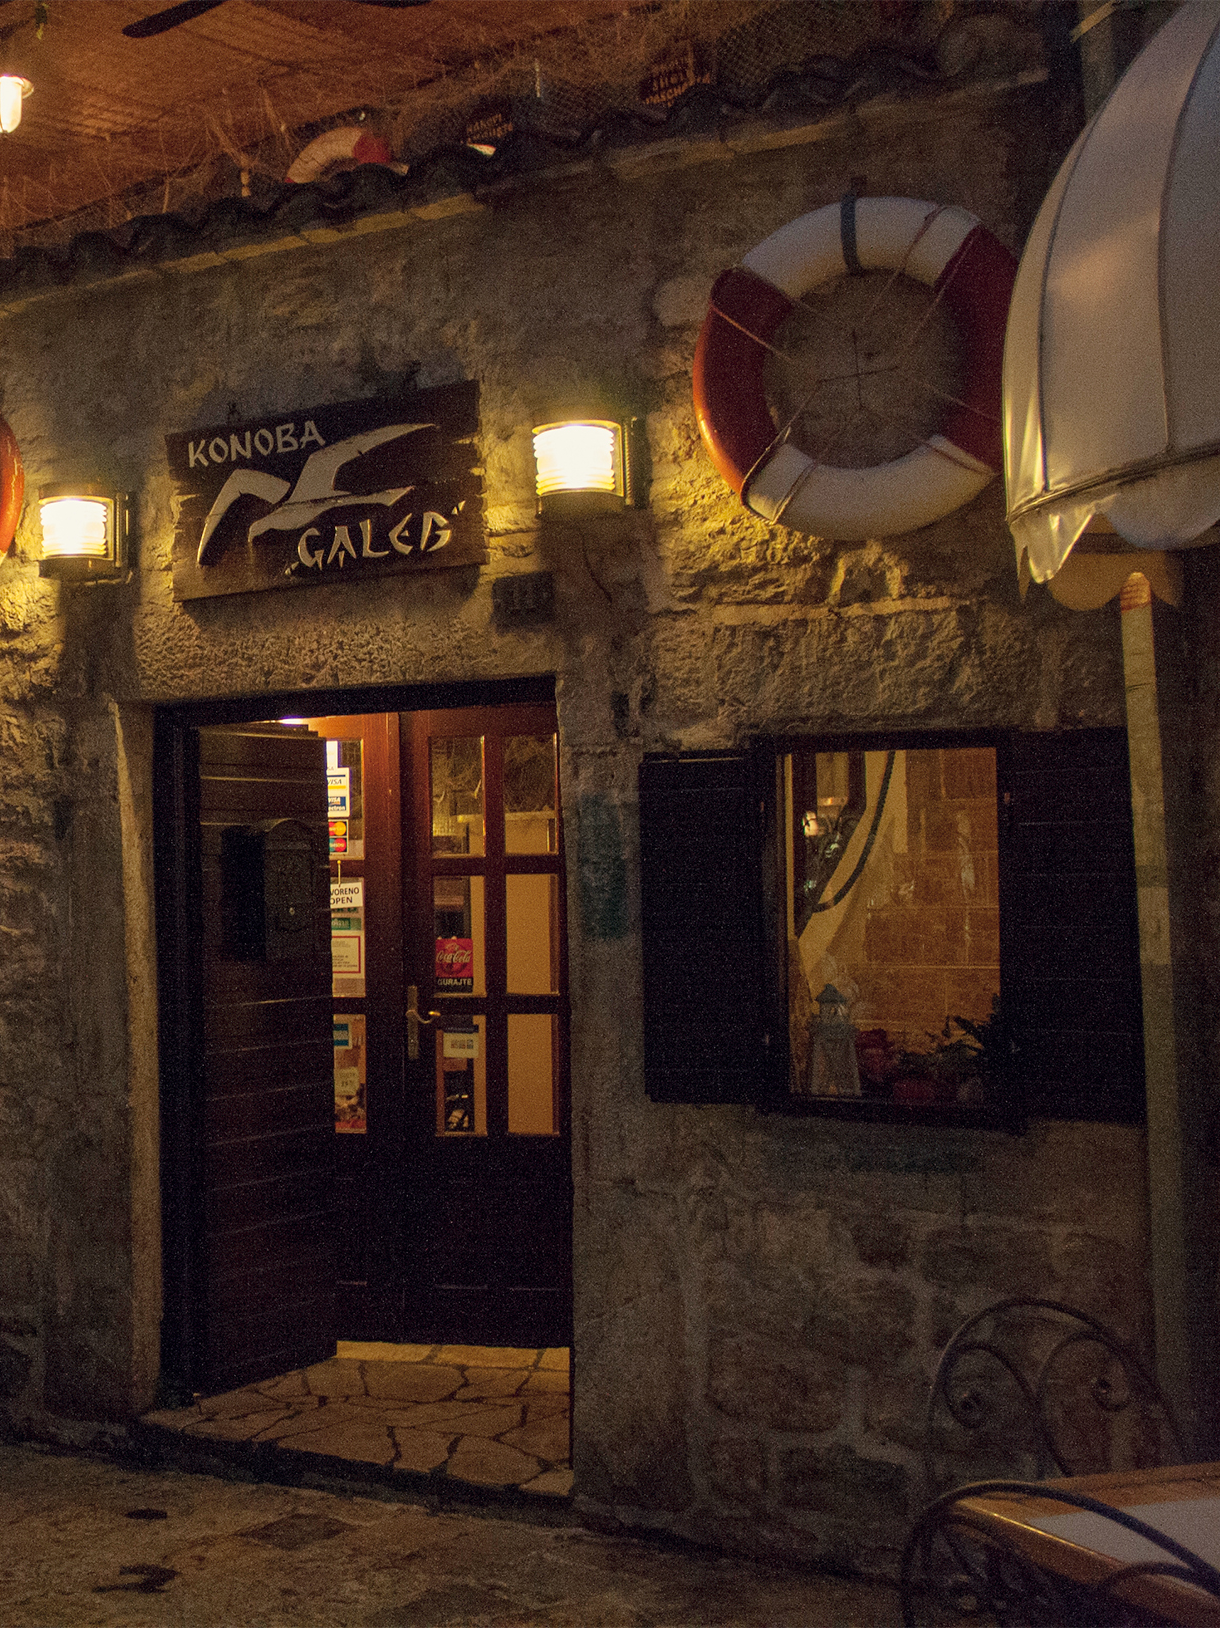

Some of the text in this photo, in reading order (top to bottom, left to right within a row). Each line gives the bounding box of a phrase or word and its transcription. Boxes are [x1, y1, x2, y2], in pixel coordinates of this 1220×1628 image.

[187, 420, 326, 469] KONOBA
[330, 887, 360, 896] VORENO
[330, 896, 353, 905] OPEN
